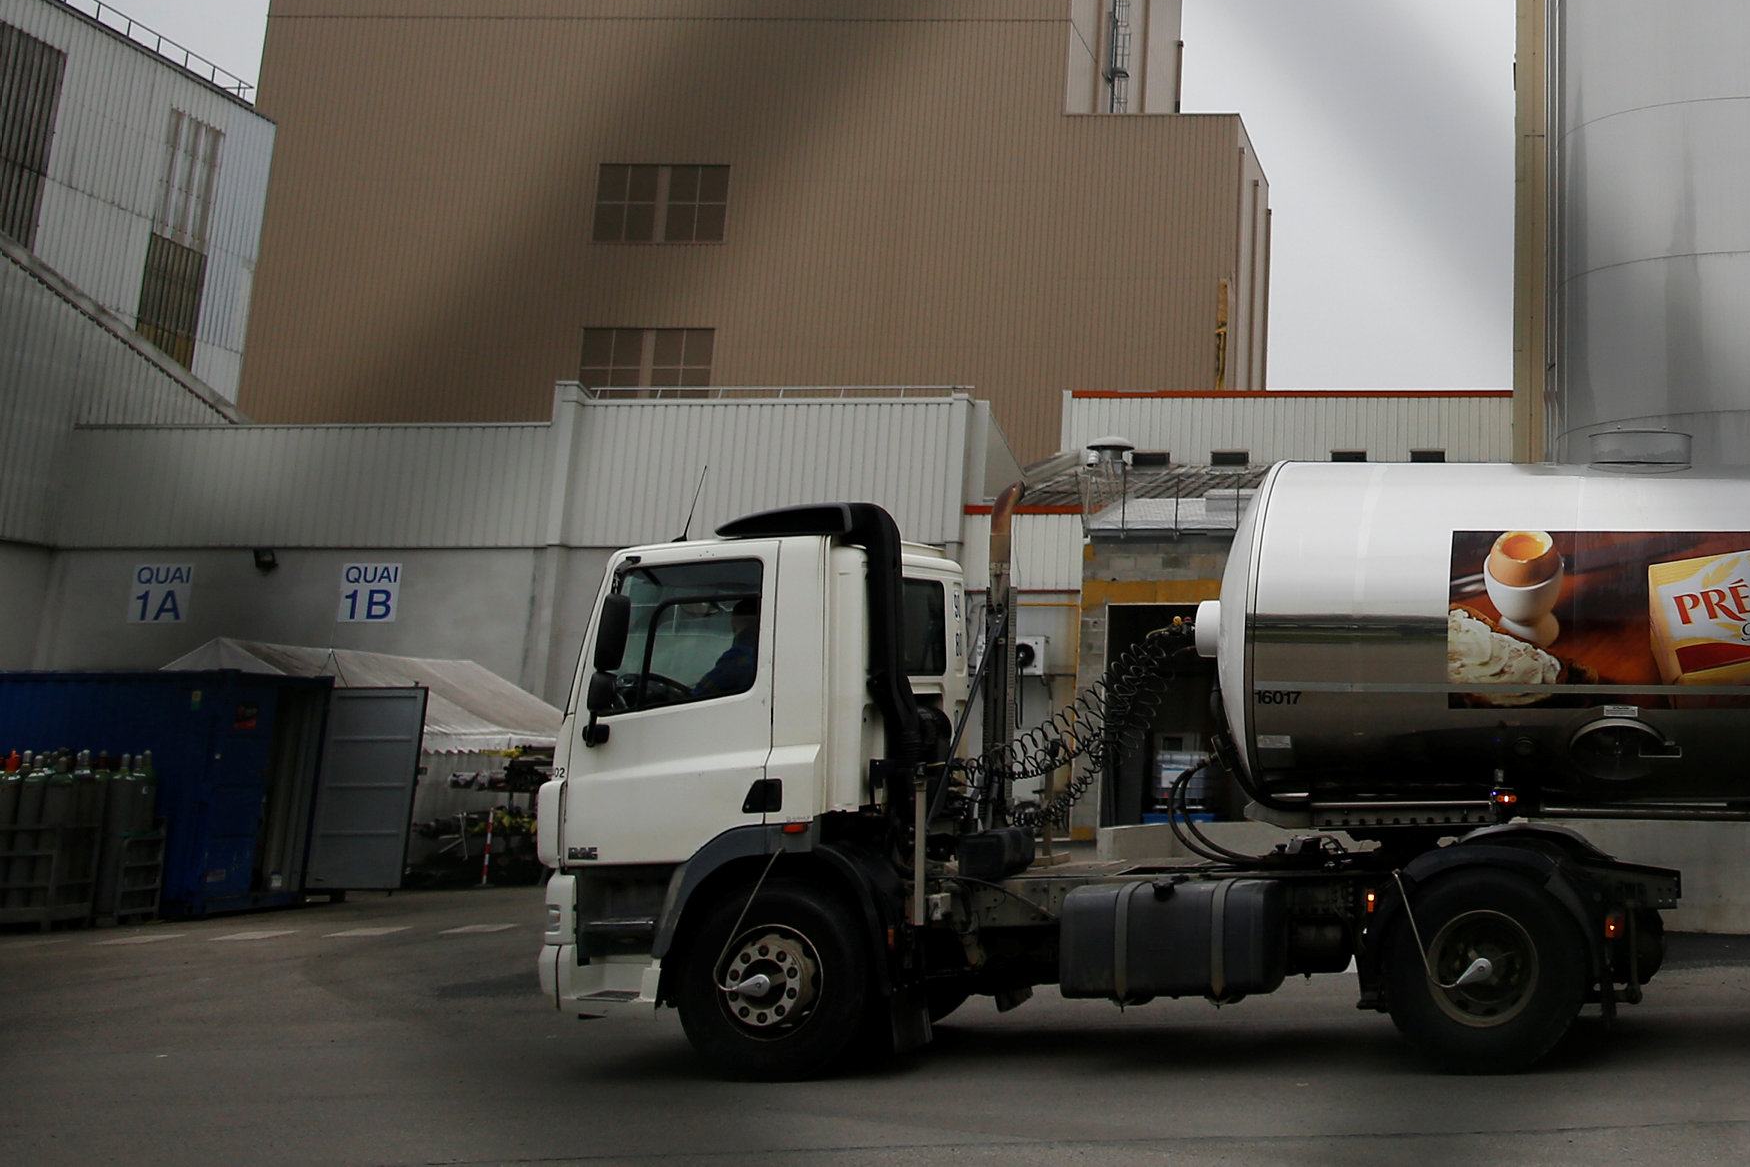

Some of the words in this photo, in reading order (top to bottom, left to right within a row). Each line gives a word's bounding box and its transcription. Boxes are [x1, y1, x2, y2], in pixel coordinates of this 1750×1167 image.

[136, 566, 192, 585] QUAI
[345, 566, 399, 584] QUAI
[135, 589, 181, 621] 1A
[344, 589, 392, 620] 1B
[1254, 689, 1302, 705] 16017
